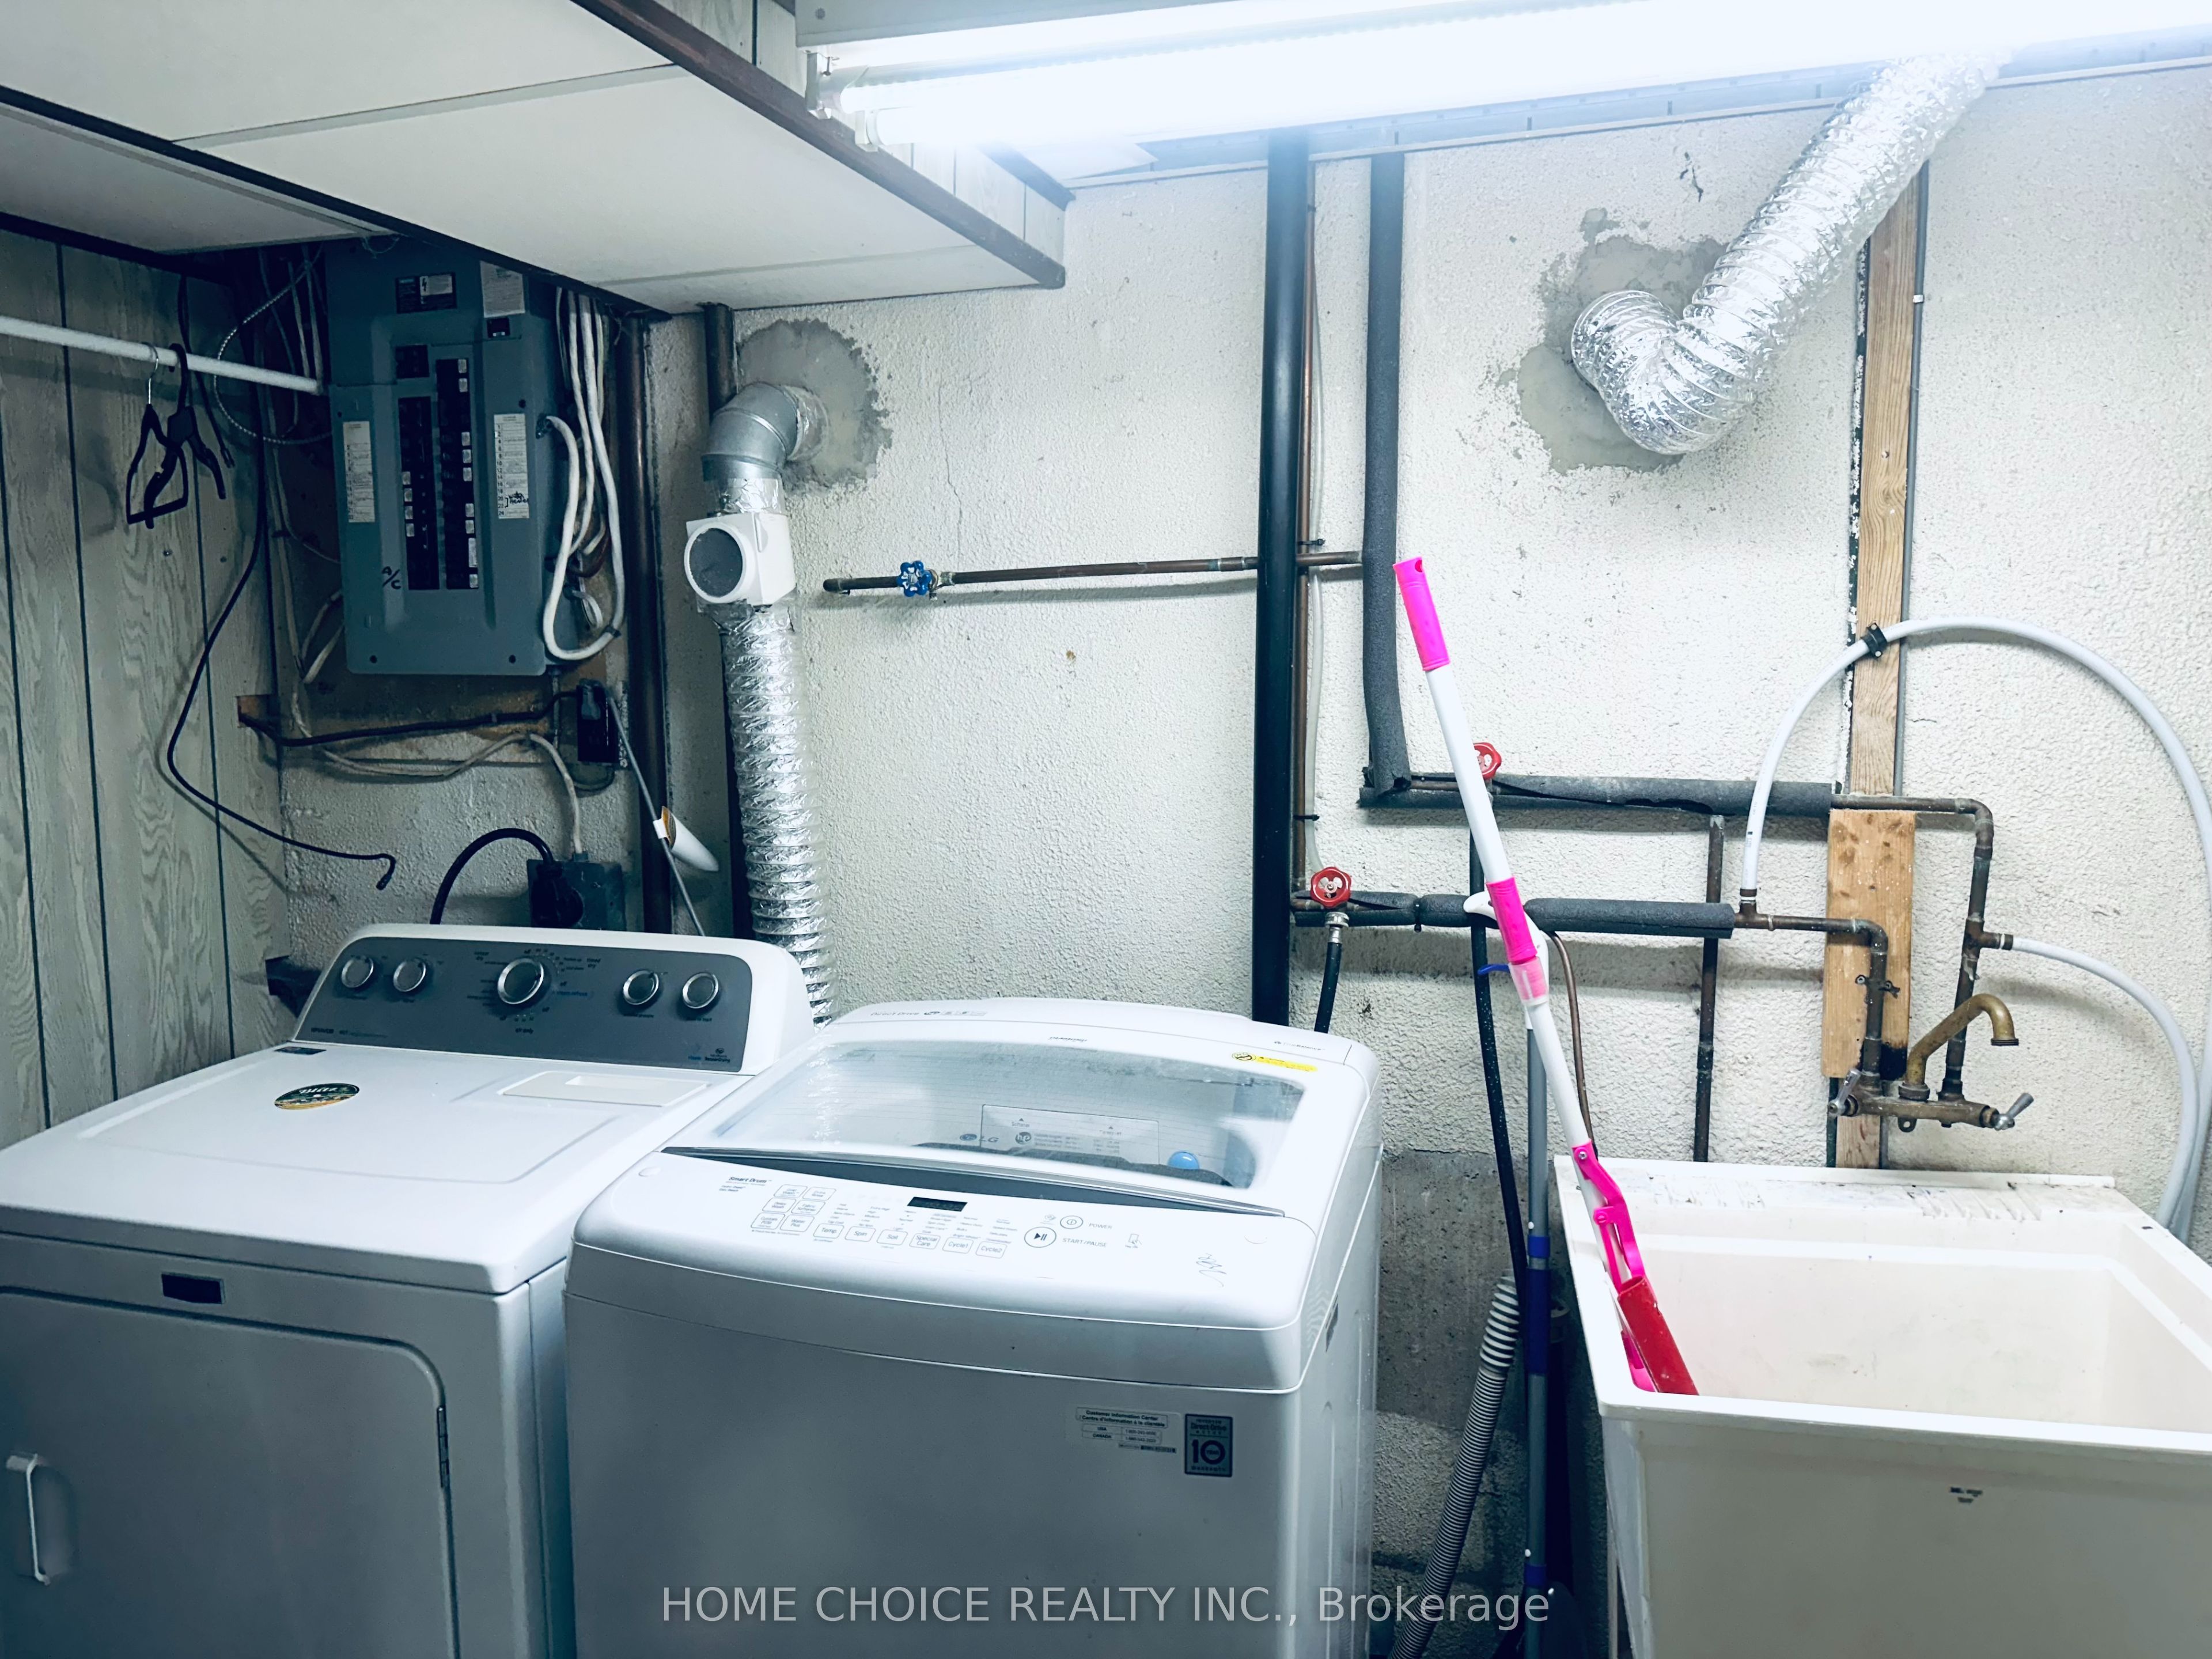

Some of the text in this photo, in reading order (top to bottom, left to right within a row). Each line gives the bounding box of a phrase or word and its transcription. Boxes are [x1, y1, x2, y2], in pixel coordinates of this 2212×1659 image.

[381, 566, 402, 590] A/C
[980, 1245, 1002, 1253] Cycle2
[1062, 1237, 1107, 1248] START/PAUSE
[1192, 1439, 1226, 1465] 10
